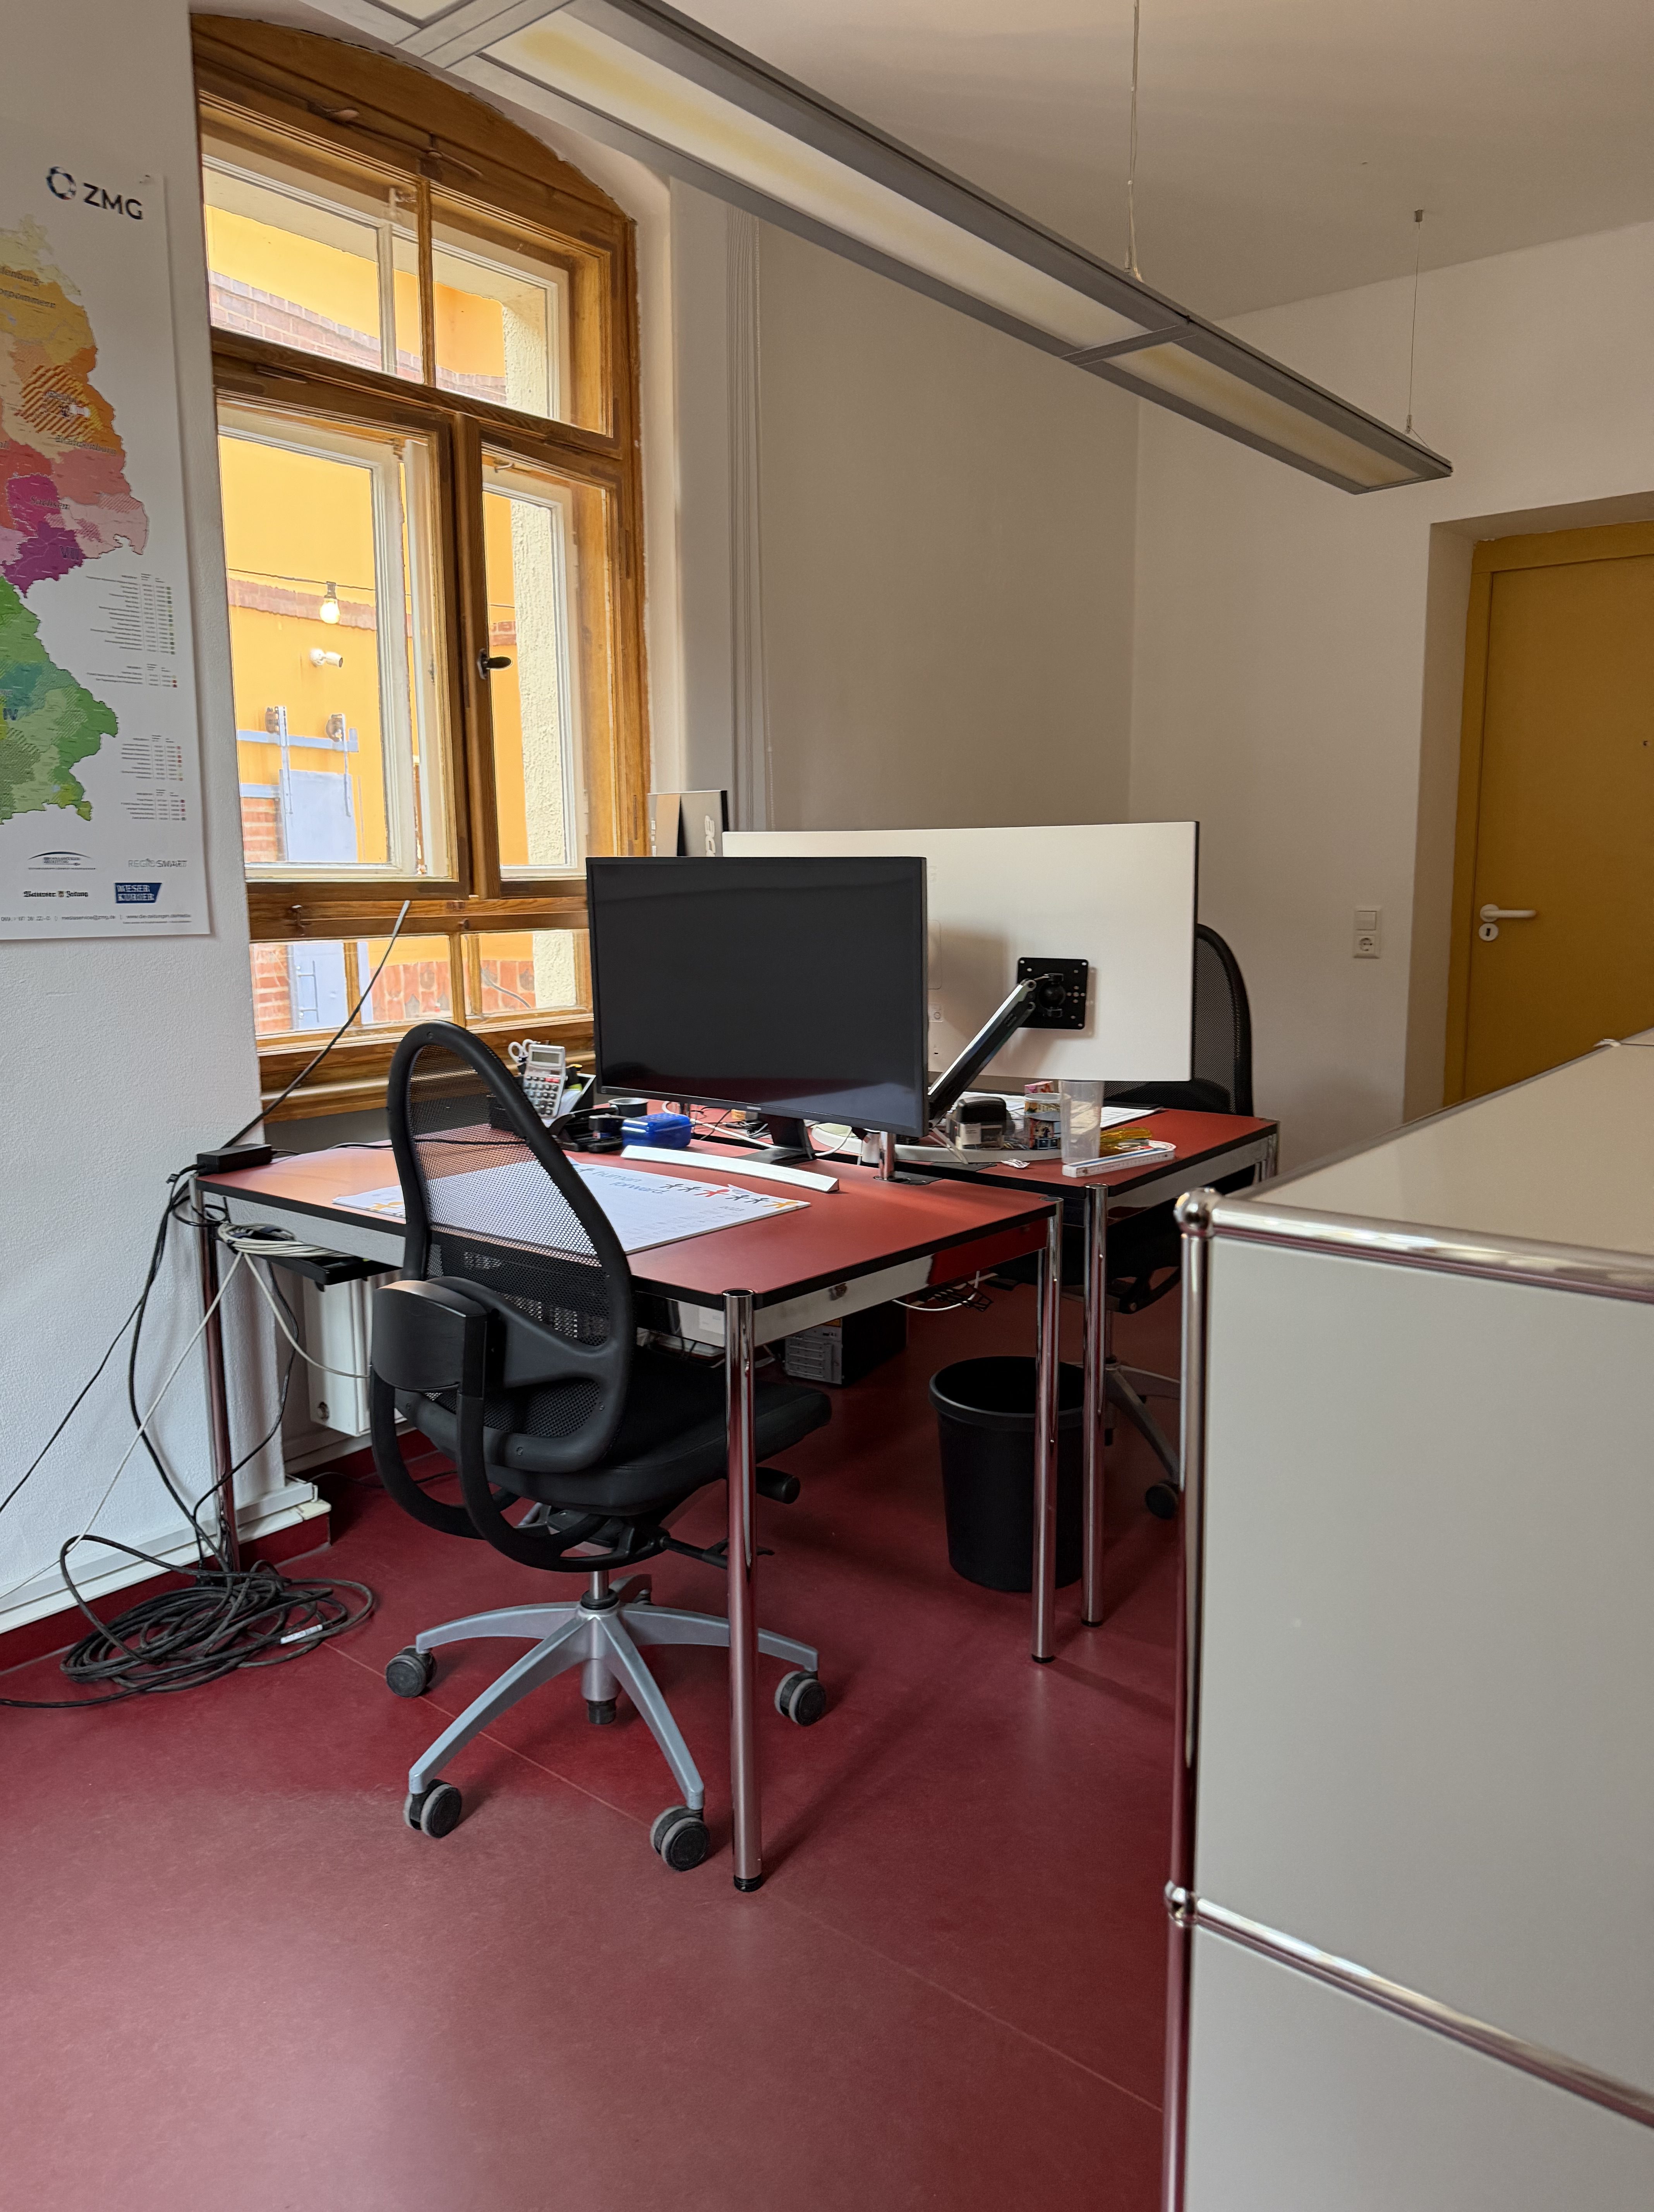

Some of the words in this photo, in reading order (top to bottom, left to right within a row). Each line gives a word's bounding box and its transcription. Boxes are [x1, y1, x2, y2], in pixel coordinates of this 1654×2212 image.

[82, 182, 144, 220] ZMG
[31, 496, 70, 510] Sachsen
[592, 1171, 642, 1182] human
[609, 1182, 670, 1194] forward.
